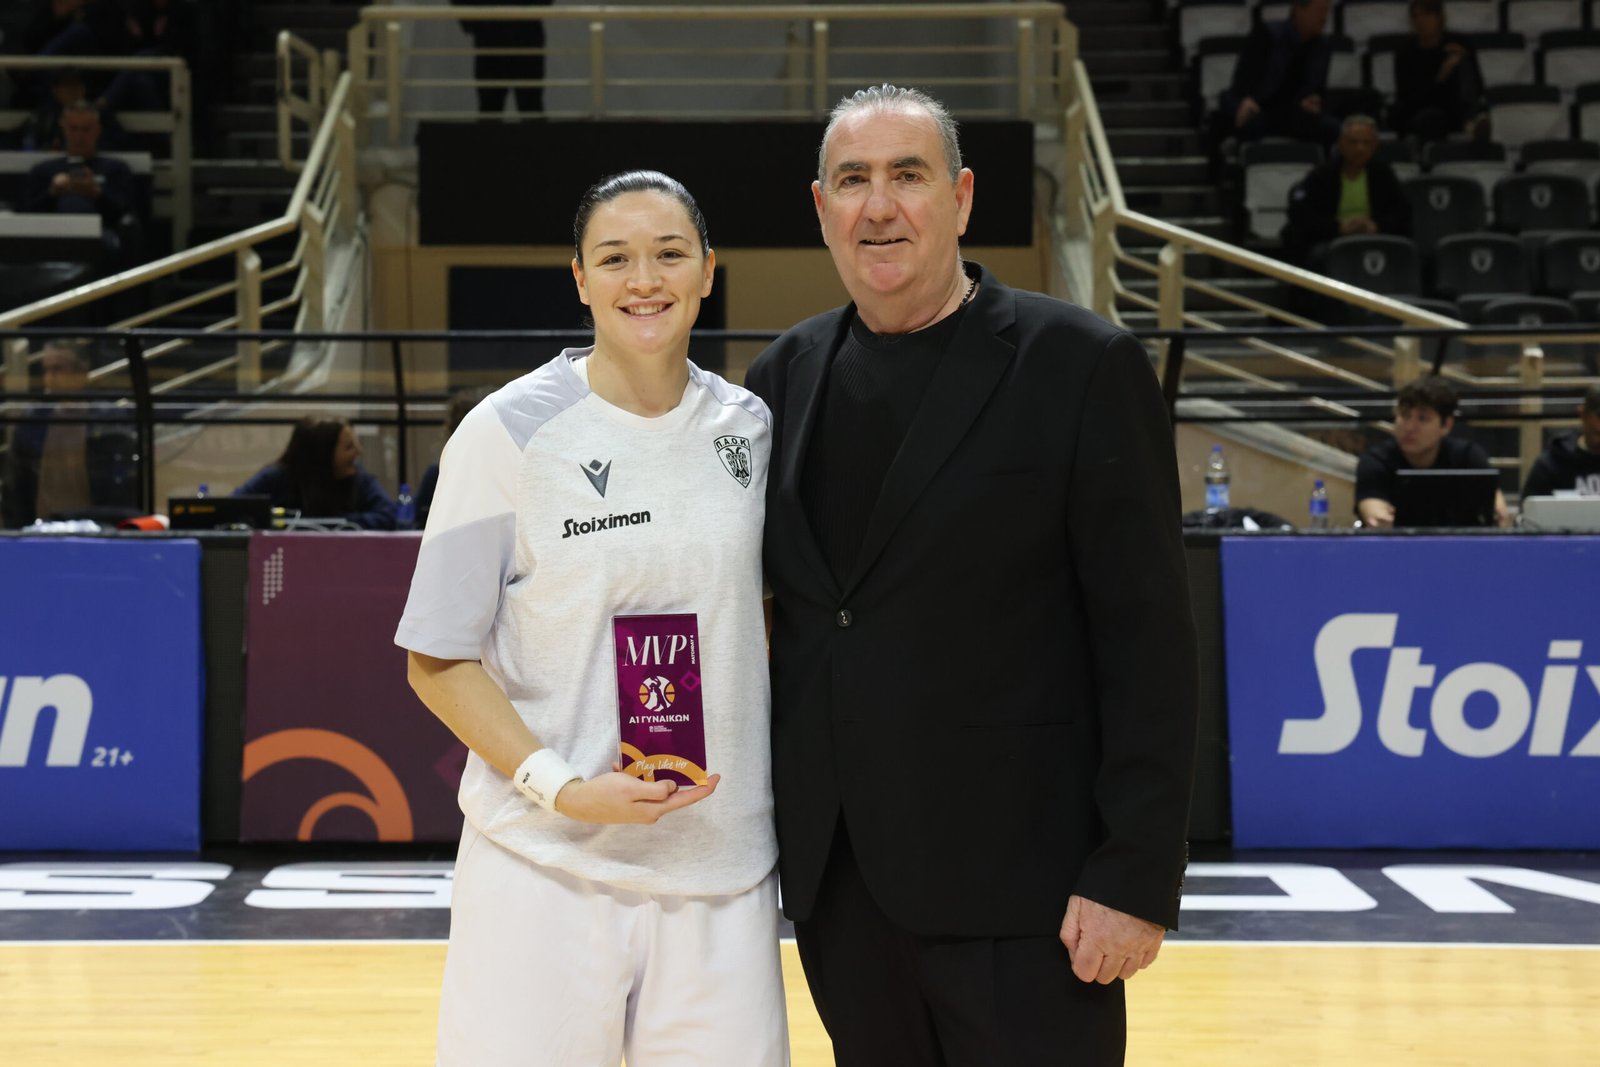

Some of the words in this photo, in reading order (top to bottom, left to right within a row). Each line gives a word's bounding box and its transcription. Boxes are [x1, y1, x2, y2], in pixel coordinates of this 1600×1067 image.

[562, 510, 651, 538] Stoiximan
[623, 634, 687, 666] MVP
[641, 714, 690, 723] ΓΥΝΑΙΚΩΝ
[91, 746, 134, 767] 21+
[636, 759, 655, 777] Play
[657, 758, 674, 770] Like
[675, 759, 688, 769] Her
